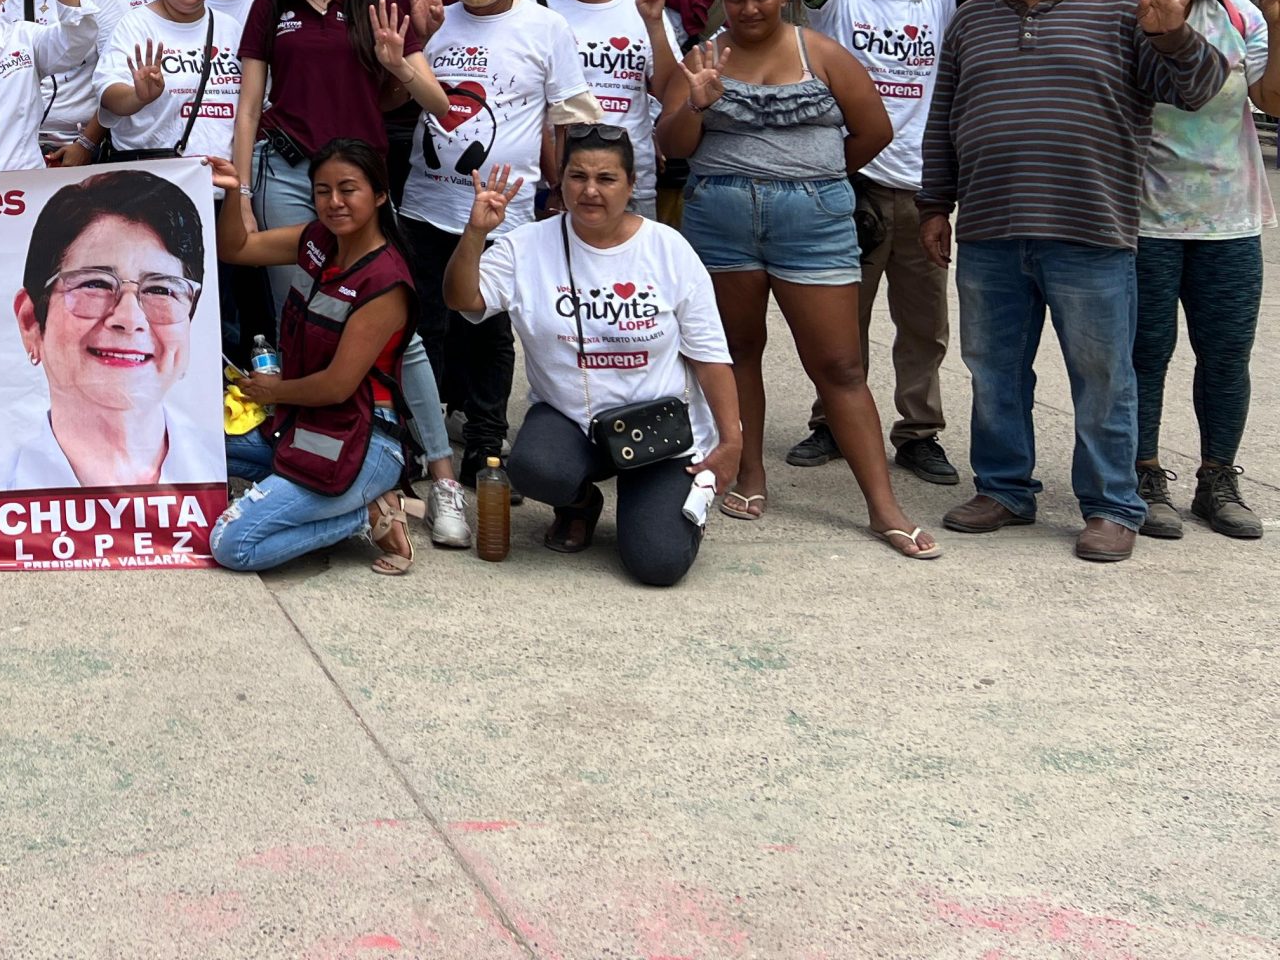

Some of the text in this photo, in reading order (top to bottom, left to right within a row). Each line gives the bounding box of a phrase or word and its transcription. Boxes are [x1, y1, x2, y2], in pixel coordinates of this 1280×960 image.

[852, 30, 935, 61] Chuyita
[433, 55, 488, 69] Chuyita
[601, 336, 629, 344] PUERTO
[631, 330, 665, 343] VALLARTA
[15, 530, 194, 561] LÓPEZ
[23, 553, 191, 569] PRESIDENTA VALLARTA
